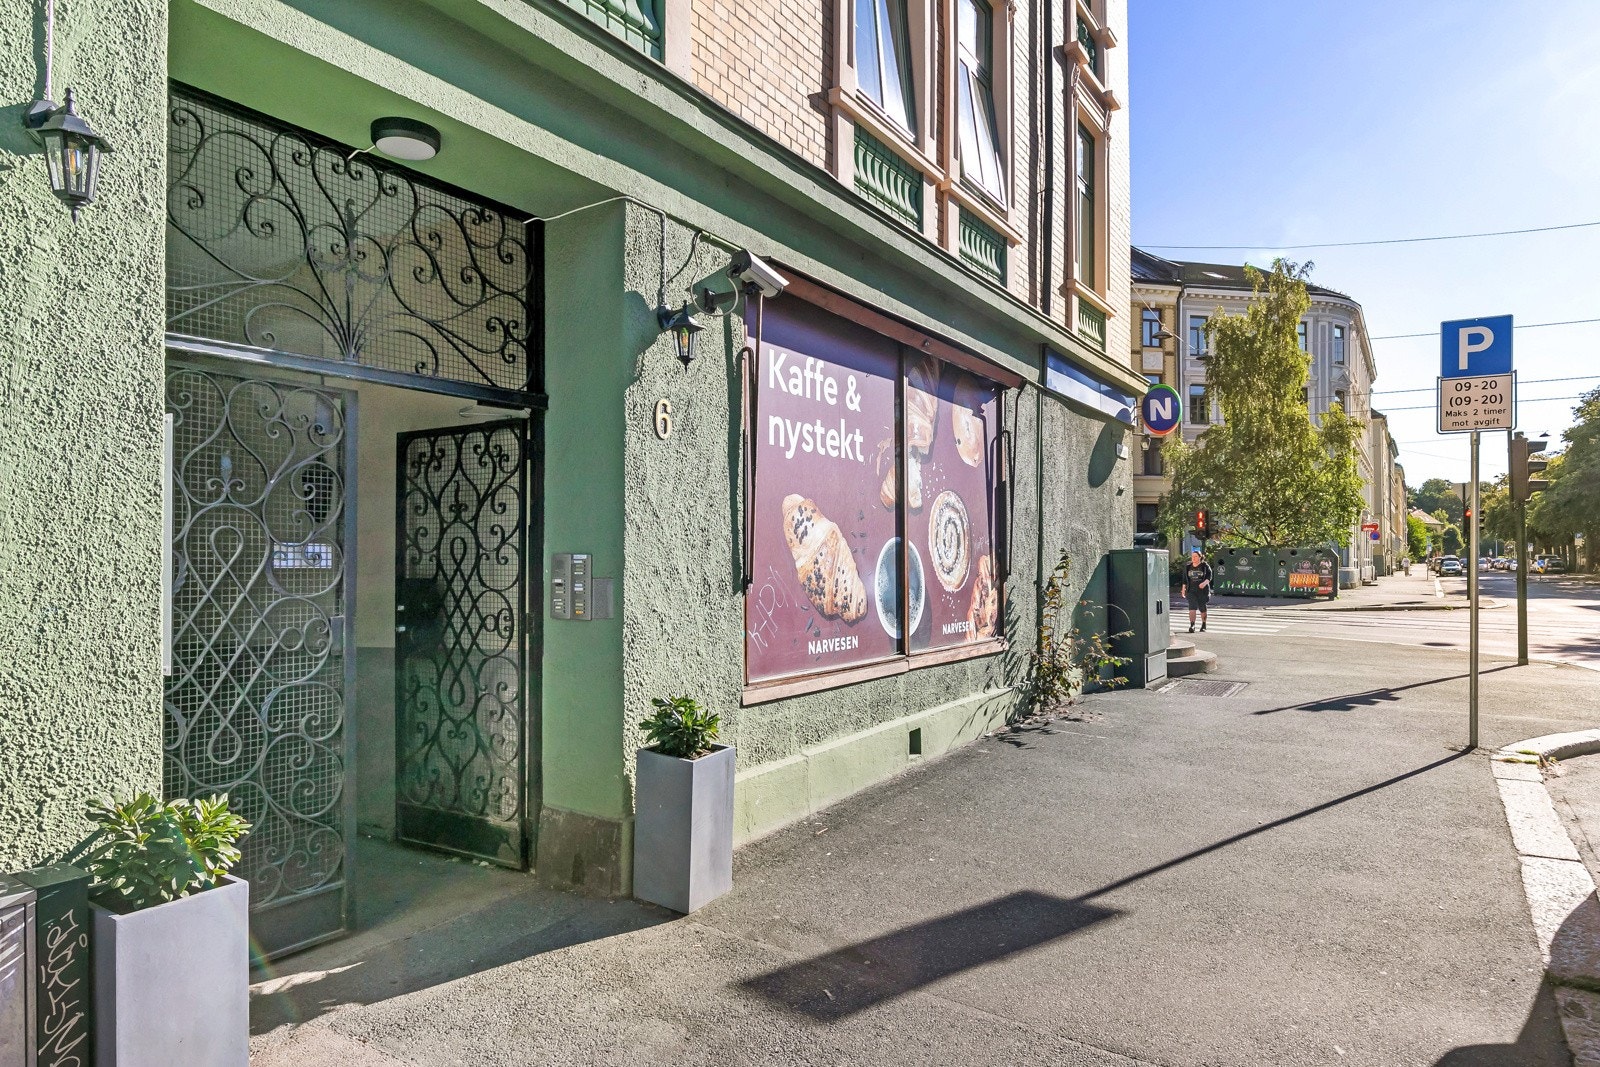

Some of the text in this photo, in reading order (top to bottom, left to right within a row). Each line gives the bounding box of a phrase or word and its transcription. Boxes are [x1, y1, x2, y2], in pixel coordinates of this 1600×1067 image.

[1458, 326, 1495, 370] P
[768, 348, 862, 412] Kaffe &
[655, 398, 673, 440] 6
[1149, 397, 1172, 422] N
[1445, 407, 1507, 418] Maks 2 timer
[1451, 417, 1500, 427] mot avgift
[768, 414, 865, 463] nystekt
[808, 635, 859, 655] NARVESEN
